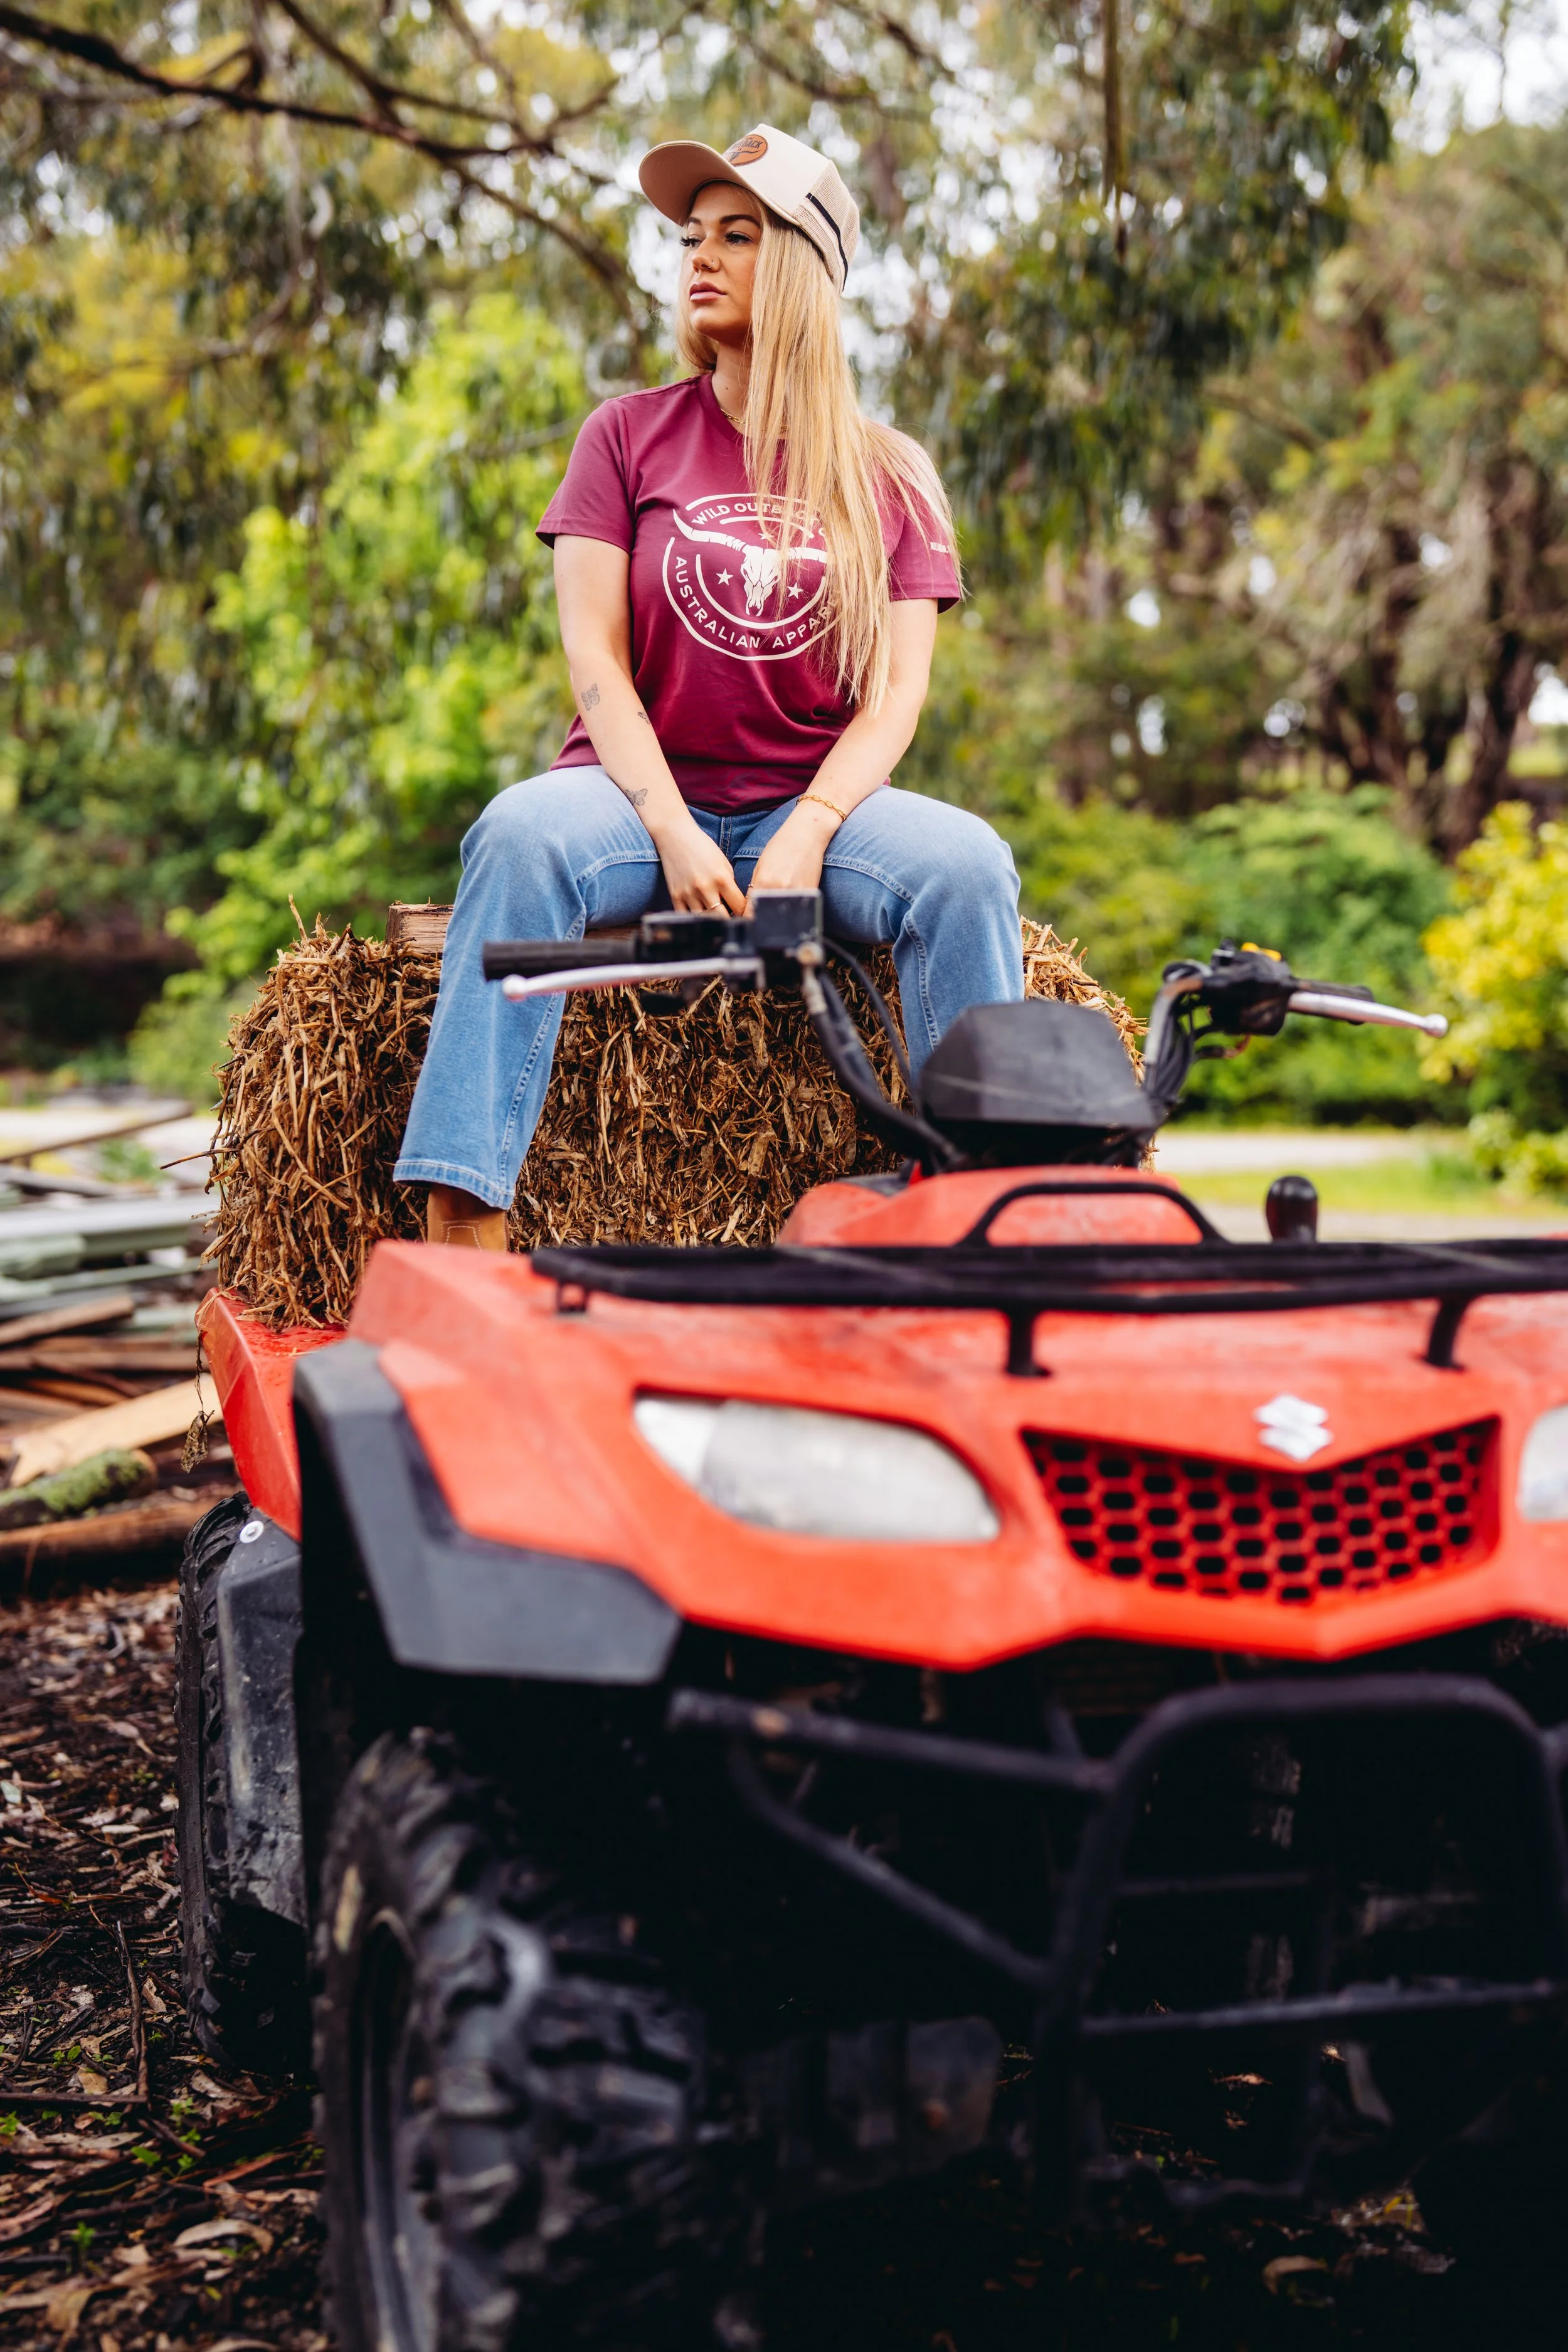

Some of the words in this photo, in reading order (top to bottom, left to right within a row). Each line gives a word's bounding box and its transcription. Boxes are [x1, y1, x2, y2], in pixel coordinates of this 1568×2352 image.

[691, 504, 730, 525] WILD
[675, 556, 760, 649] AUSTRALIAN
[772, 590, 840, 649] APPARE
